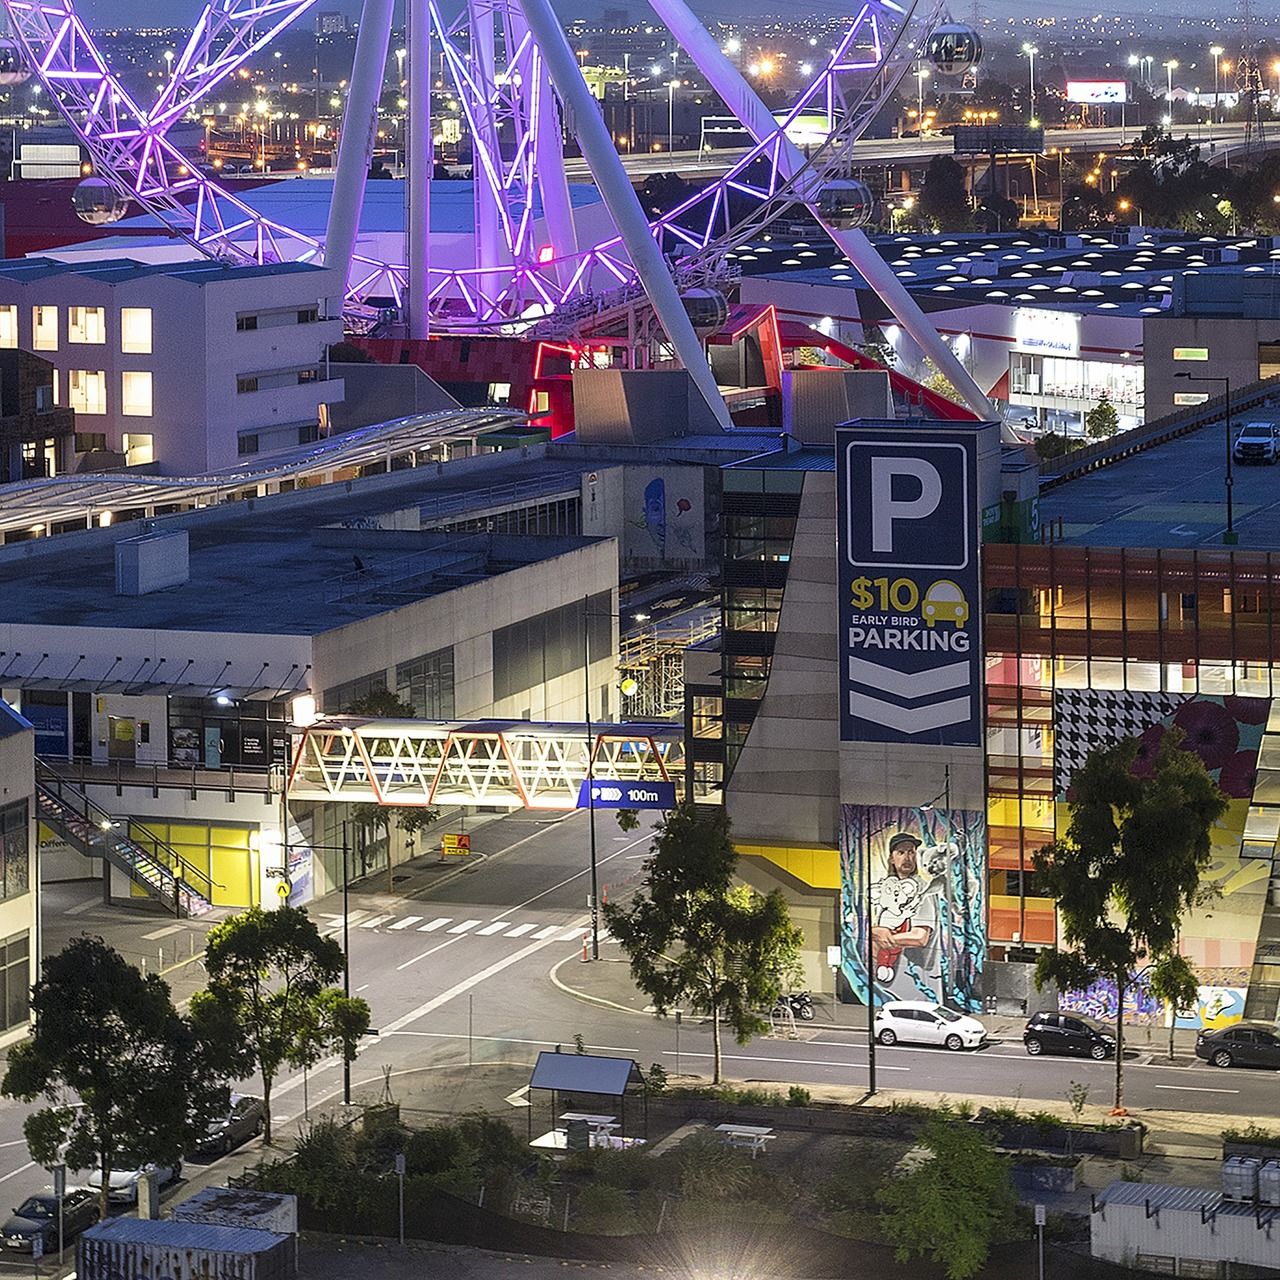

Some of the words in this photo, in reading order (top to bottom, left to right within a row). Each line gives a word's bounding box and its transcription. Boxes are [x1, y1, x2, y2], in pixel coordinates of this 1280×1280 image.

[871, 456, 942, 552] P
[851, 576, 919, 612] $10
[852, 615, 888, 625] EARLY
[849, 627, 970, 652] PARKING
[627, 789, 659, 802] 100m
